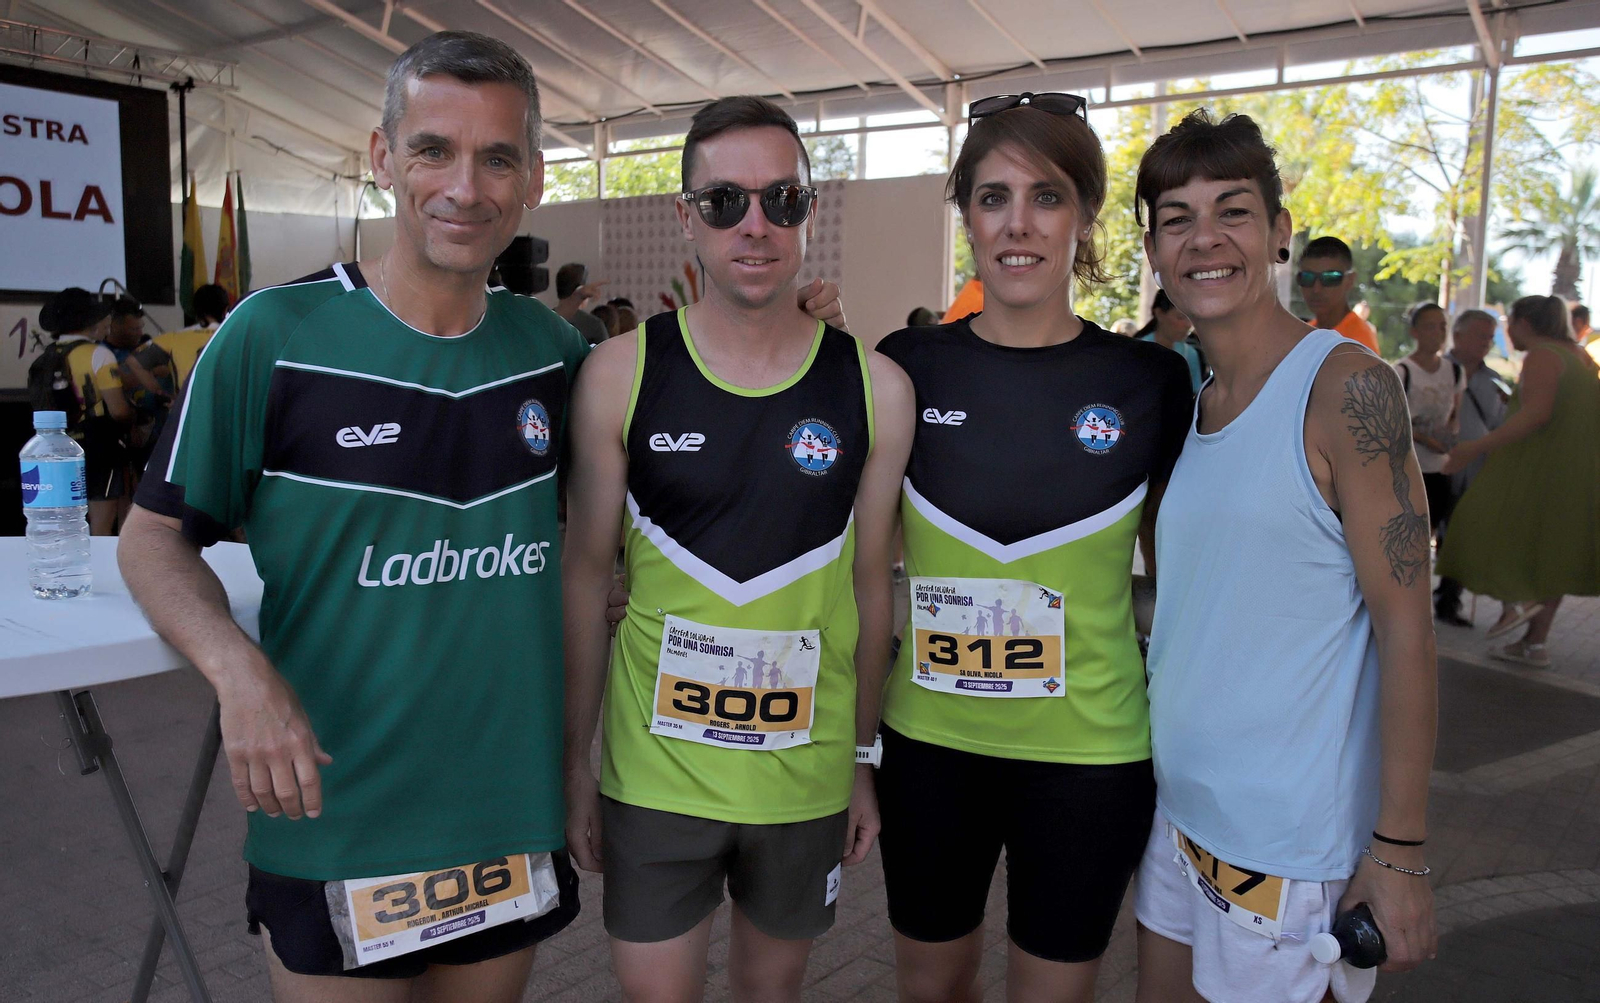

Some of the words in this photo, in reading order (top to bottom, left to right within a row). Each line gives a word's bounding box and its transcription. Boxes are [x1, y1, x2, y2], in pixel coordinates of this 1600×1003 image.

[2, 114, 89, 146] STRA
[0, 175, 115, 225] OLA
[799, 466, 828, 477] GIBRALTAR
[357, 533, 550, 587] Ladbrokes
[916, 591, 929, 603] POR
[944, 594, 974, 607] SONRISA
[668, 634, 682, 648] POR
[683, 638, 698, 652] UNA
[699, 642, 734, 658] SONRISA
[928, 633, 1044, 670] 312
[959, 669, 966, 677] SA
[984, 671, 1003, 679] NICOLA
[968, 681, 995, 690] SEPTIEMBRE
[994, 683, 1008, 691] 2025
[672, 680, 799, 723] 300
[657, 720, 673, 729] MASTER
[709, 719, 730, 729] ROGERS
[734, 723, 757, 732] ARNOLD
[718, 731, 746, 743] SEPTIEMBRE
[746, 736, 760, 744] 2025
[372, 856, 512, 924] 306
[441, 907, 464, 919] ARTHUR
[464, 898, 490, 914] MICHAEL
[513, 899, 519, 909] L
[429, 928, 437, 936] 13
[436, 919, 467, 935] SEPTIEMBRE
[467, 914, 481, 926] 2025
[1253, 915, 1263, 925] XS
[362, 942, 382, 953] MASTER
